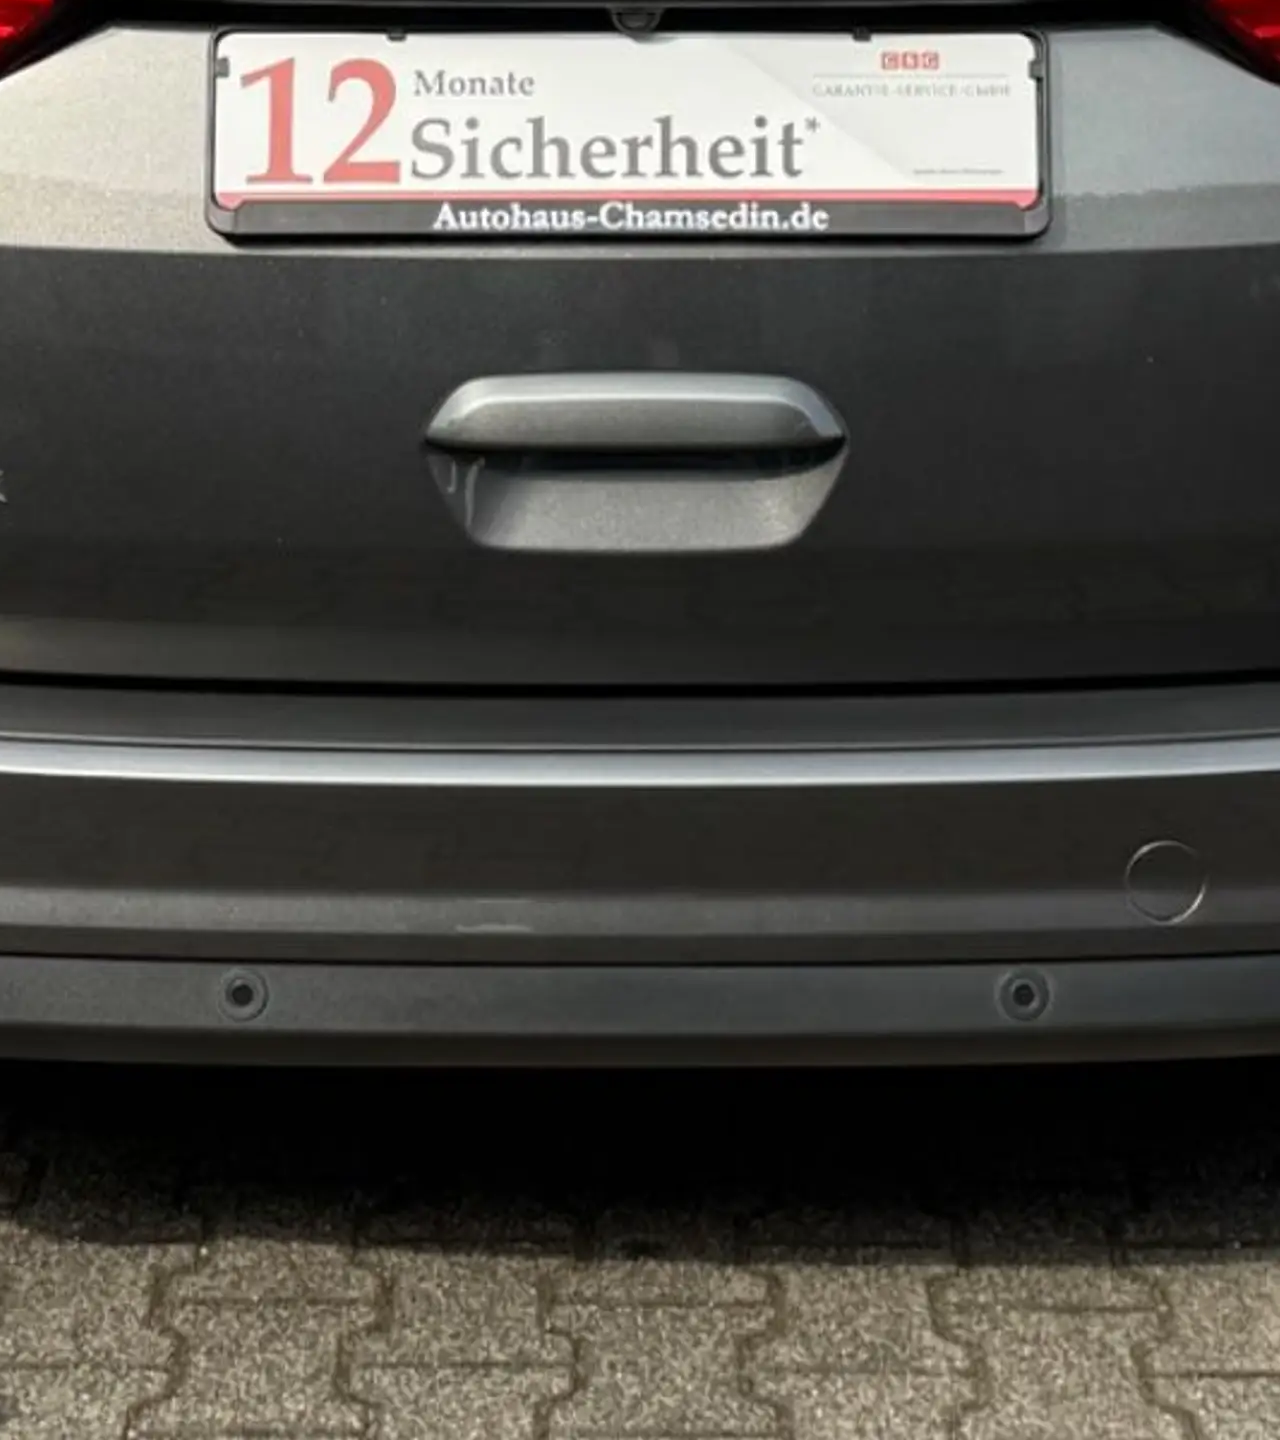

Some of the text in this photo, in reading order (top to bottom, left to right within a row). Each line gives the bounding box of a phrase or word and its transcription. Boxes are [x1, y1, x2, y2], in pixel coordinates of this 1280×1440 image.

[240, 57, 535, 185] 12 Monate
[433, 203, 829, 232] Autohaus-Chamsedin.de
